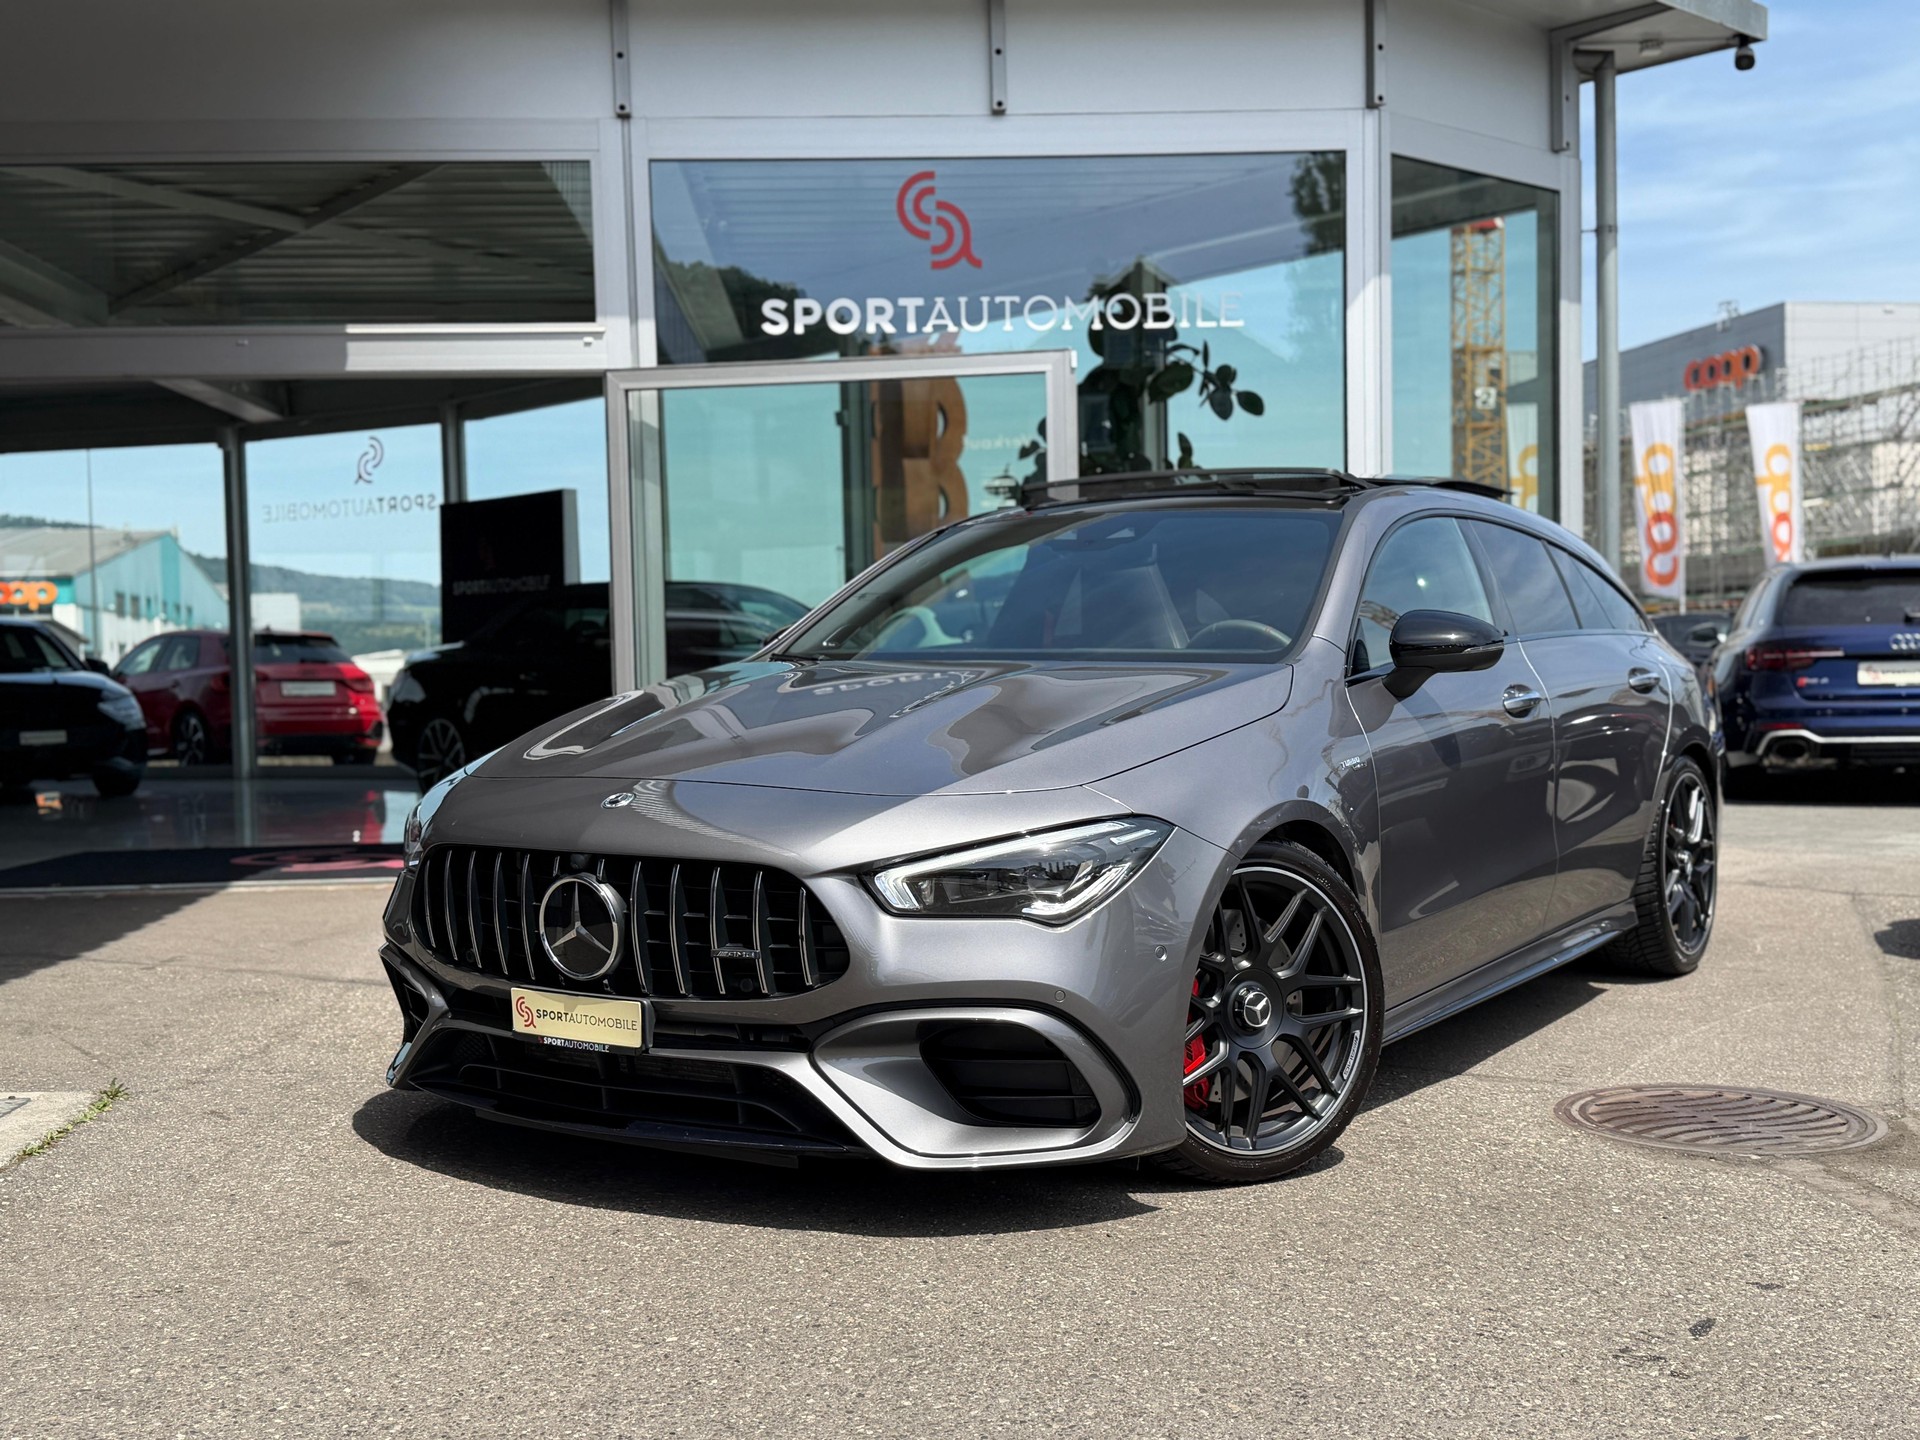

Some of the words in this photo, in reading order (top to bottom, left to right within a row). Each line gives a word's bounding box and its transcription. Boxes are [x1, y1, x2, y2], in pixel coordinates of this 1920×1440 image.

[760, 291, 1245, 336] SPORTAUTOMOBILE
[1683, 345, 1761, 391] coop
[1634, 442, 1679, 587] coop
[536, 1008, 638, 1031] SPORTAUTOMOBILE
[543, 1036, 610, 1053] SPORTAUTOMOBILE
